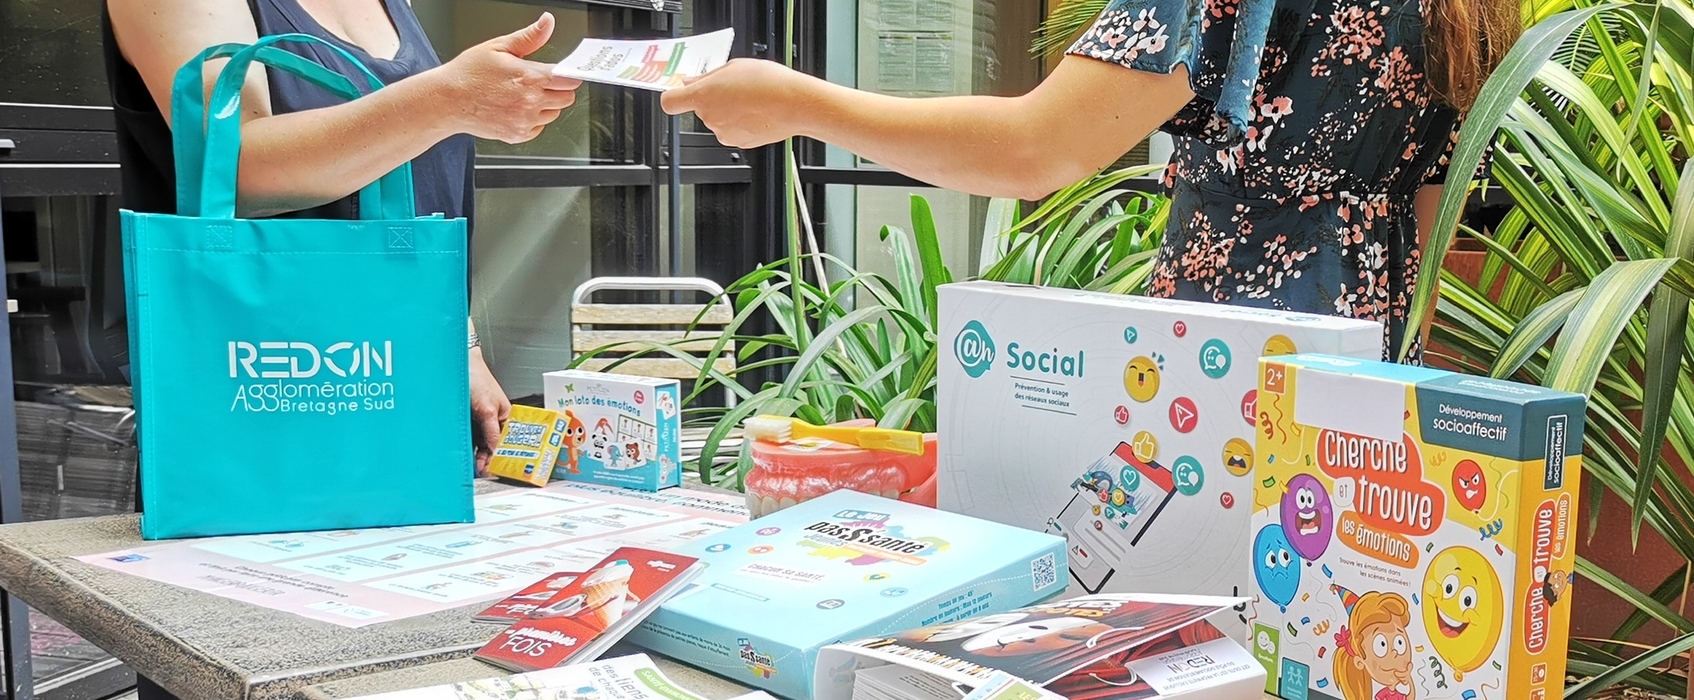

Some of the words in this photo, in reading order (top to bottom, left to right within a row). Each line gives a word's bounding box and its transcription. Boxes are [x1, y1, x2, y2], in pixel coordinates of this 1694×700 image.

[228, 340, 392, 378] REDON
[1006, 341, 1084, 378] Social
[1014, 382, 1046, 394] Prévention
[1051, 389, 1069, 398] usage
[1266, 367, 1283, 386] 2+
[231, 379, 394, 412] Agglomération
[281, 399, 358, 416] Bretagne
[364, 397, 395, 411] Sud
[558, 398, 574, 408] Mon
[574, 394, 590, 405] loto
[592, 395, 605, 406] des
[607, 397, 641, 417] émotions
[1014, 392, 1025, 400] des
[1025, 394, 1047, 404] réseaux
[1048, 397, 1070, 407] sociaux
[1439, 403, 1502, 423] Développement
[1433, 418, 1507, 441] socioaffectif
[1547, 425, 1556, 482] Développement
[1554, 421, 1564, 485] socioaffectif
[1339, 484, 1348, 498] et
[1358, 474, 1432, 530] trouve
[1342, 516, 1355, 535] les
[1356, 523, 1411, 562] émotions
[1533, 508, 1553, 566] trouve
[1364, 562, 1388, 574] émotions
[1528, 585, 1544, 649] Cherche
[499, 636, 552, 657] FOIS
